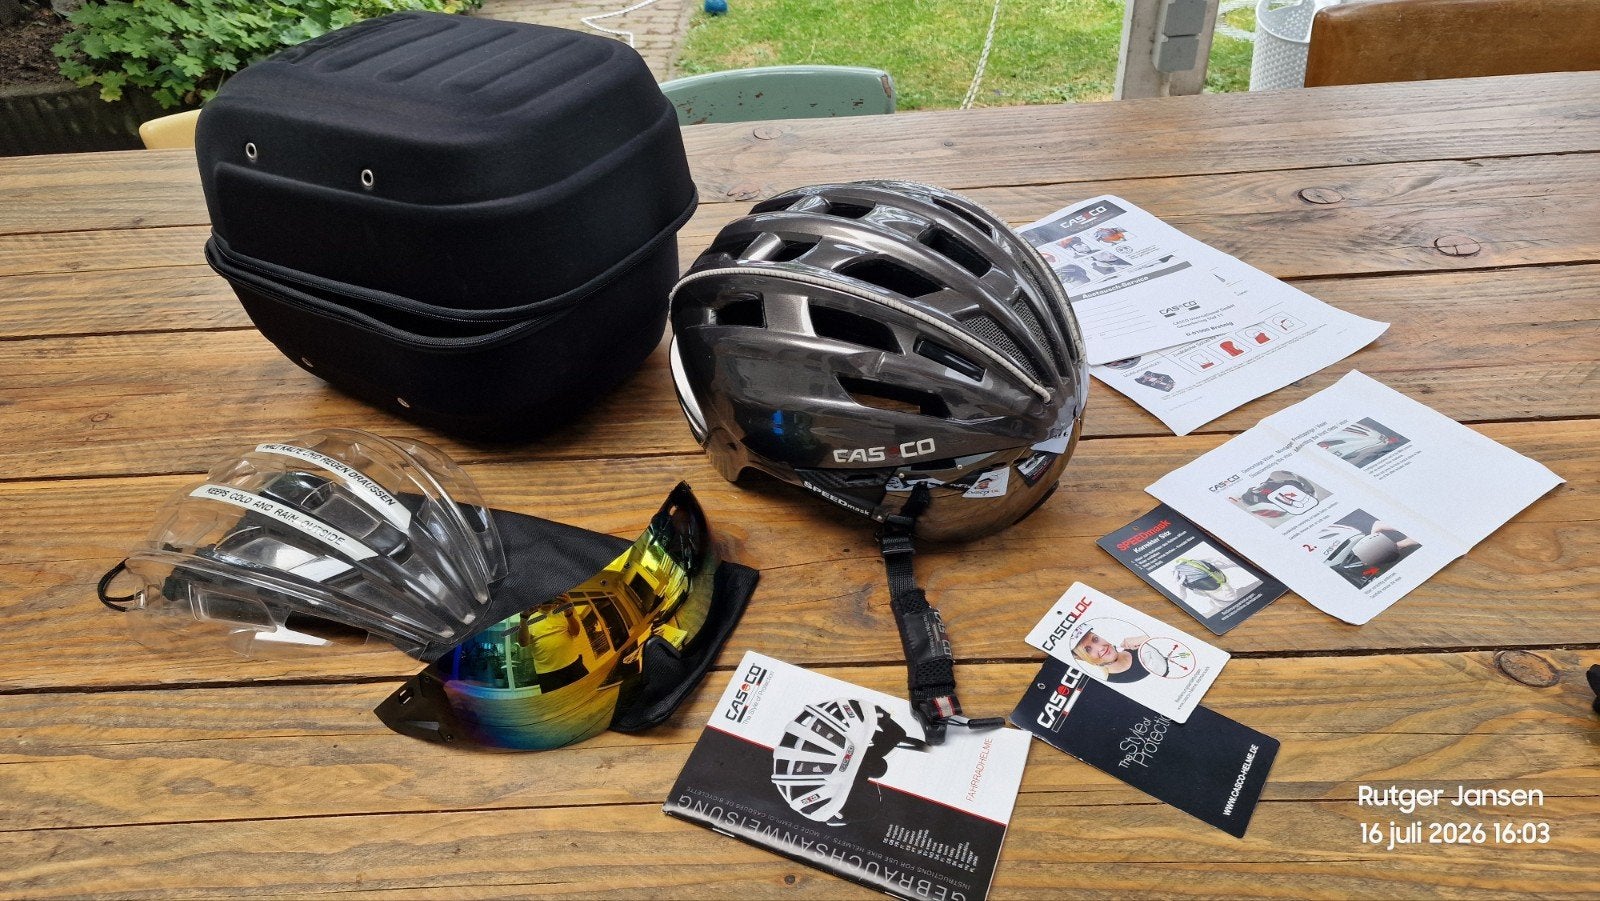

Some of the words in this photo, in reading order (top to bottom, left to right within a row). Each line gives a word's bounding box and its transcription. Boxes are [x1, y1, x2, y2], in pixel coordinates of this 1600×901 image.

[833, 437, 936, 463] CASCO
[320, 454, 350, 474] REGEN
[347, 470, 396, 507] DRAUSSEN
[803, 480, 871, 516] SPEEDmask
[206, 487, 230, 498] KEEPS
[230, 492, 253, 504] COLD
[252, 499, 274, 512] AND
[274, 508, 299, 523] RAIN
[300, 520, 346, 545] OUTSIDE
[1116, 520, 1172, 551] SPEEDmask
[1302, 544, 1317, 552] 2.
[1041, 596, 1093, 652] CASCOLOC
[725, 665, 762, 721] CASCO
[1037, 666, 1083, 729] CASCO
[1120, 722, 1148, 755] Style
[1132, 715, 1171, 768] Protecti
[966, 737, 994, 802] FAHRRADHELME
[1119, 754, 1133, 768] The
[1222, 744, 1259, 816] WWW.CASCO-HELME.DE
[677, 794, 966, 901] GEBRAUCHSANWEISUNG
[801, 826, 821, 837] MODE
[833, 837, 865, 853] HELMETS
[867, 849, 883, 859] BIKE
[884, 857, 899, 866] USE
[900, 862, 915, 871] FOR
[917, 867, 971, 890] INSTRUCTIONS
